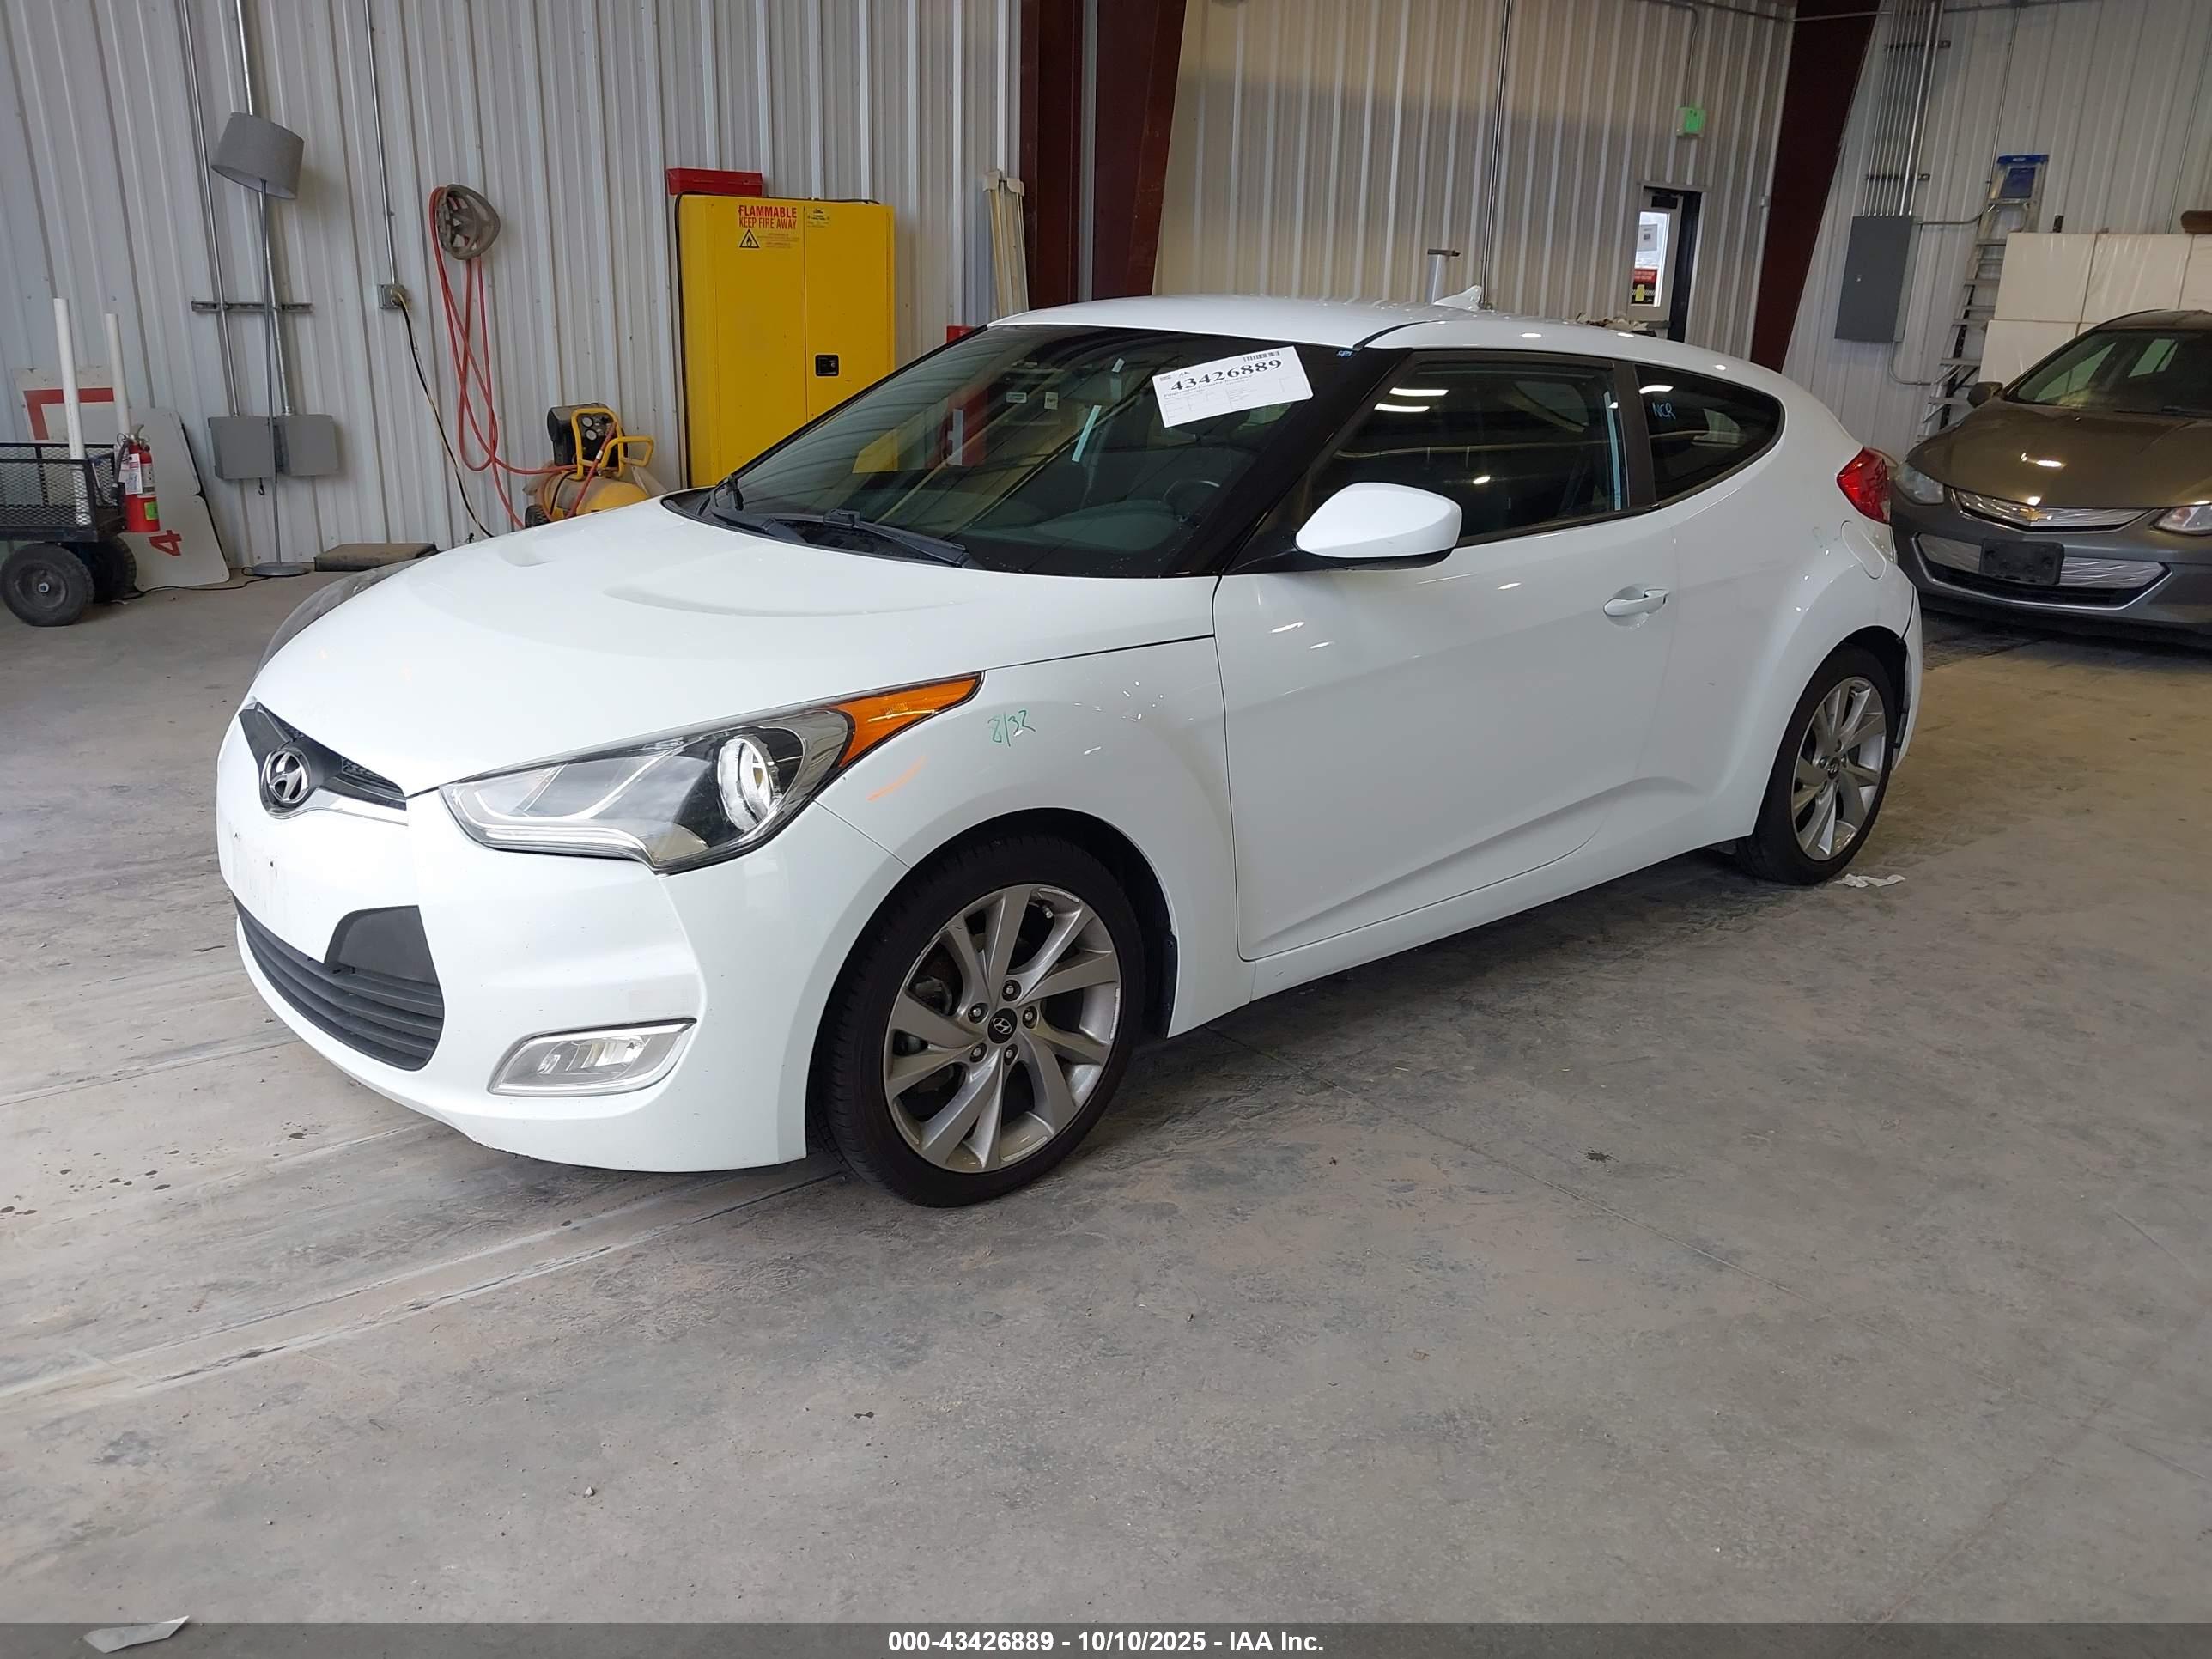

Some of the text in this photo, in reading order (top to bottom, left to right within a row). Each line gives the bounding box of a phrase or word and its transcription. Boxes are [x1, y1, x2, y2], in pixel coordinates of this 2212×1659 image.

[738, 205, 797, 218] FLAMMABLE
[739, 217, 797, 229] KEEP FIRE AWAY
[1171, 359, 1282, 391] 43426889
[1652, 402, 1676, 419] NCR
[148, 529, 182, 556] 4
